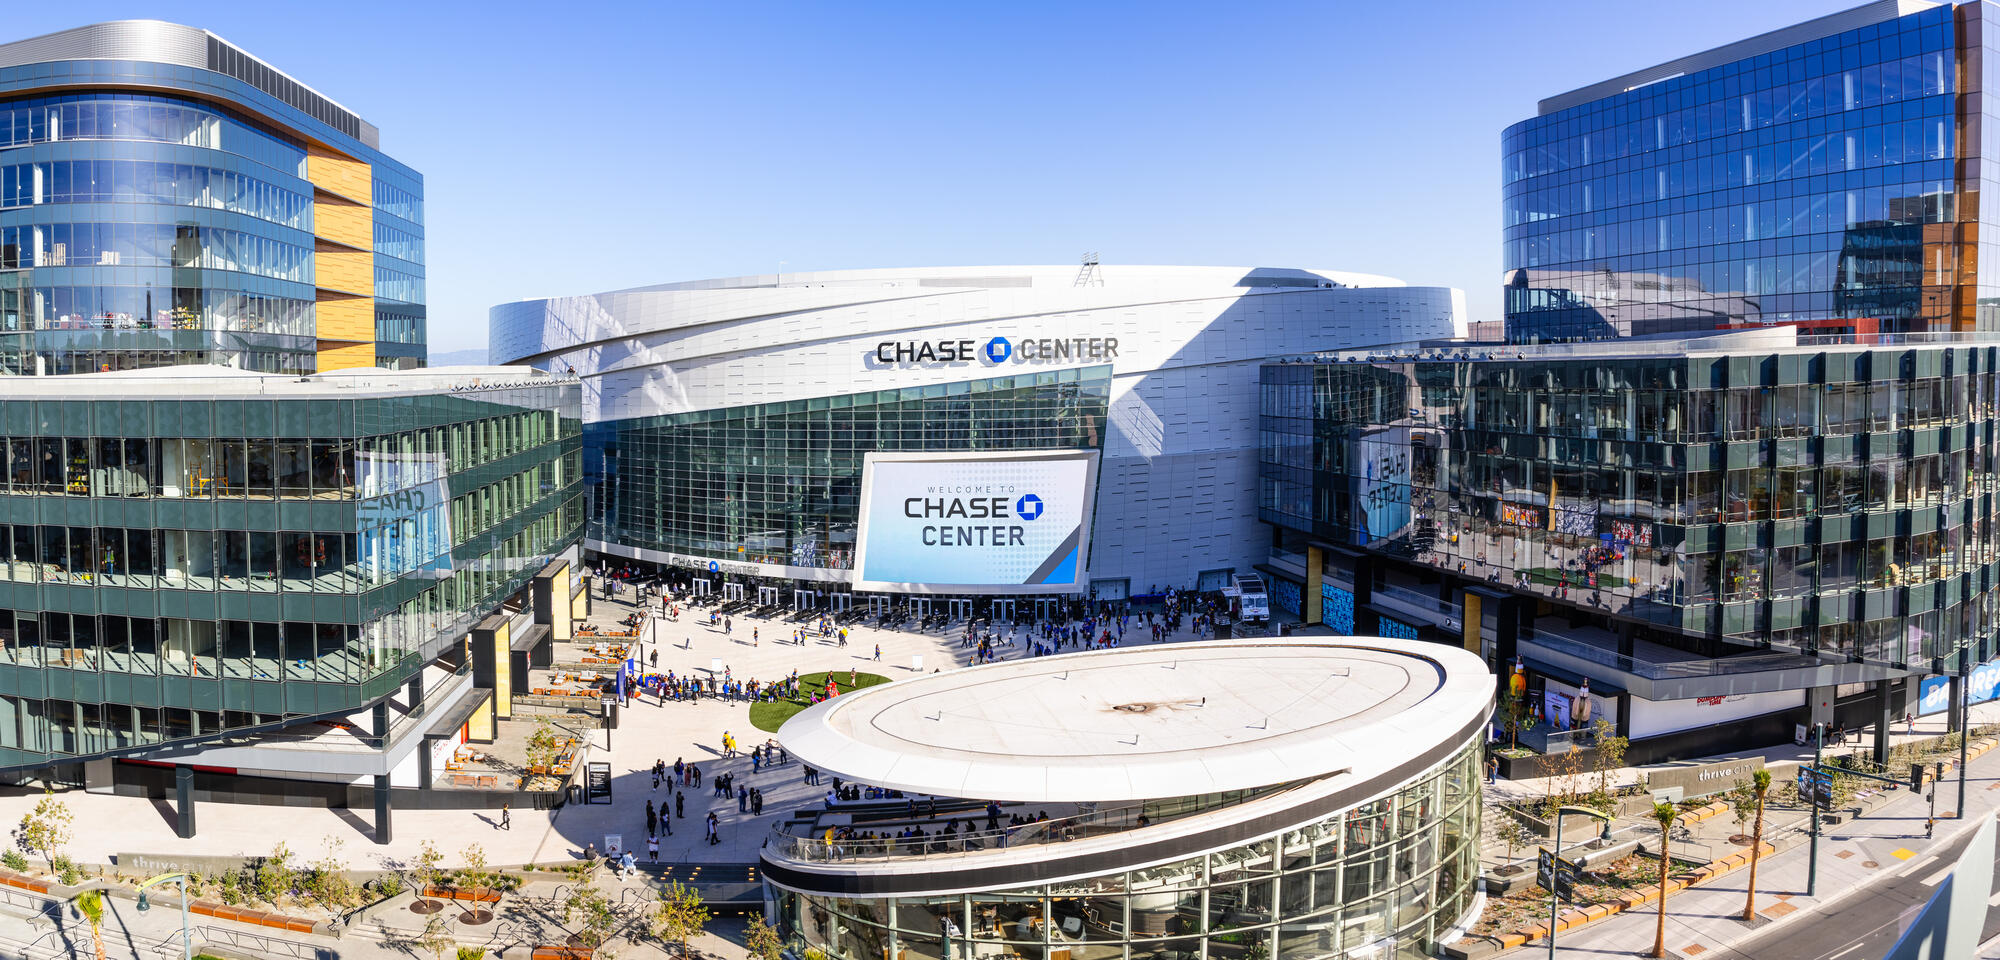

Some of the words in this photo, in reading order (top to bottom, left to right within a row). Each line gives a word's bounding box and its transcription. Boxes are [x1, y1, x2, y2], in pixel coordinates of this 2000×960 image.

[877, 340, 976, 362] CHASE
[1021, 337, 1119, 359] CENTER
[927, 486, 991, 494] WELCOME
[1000, 485, 1015, 493] TO
[904, 497, 1010, 519] CHASE
[922, 525, 1025, 547] CENTER
[672, 557, 707, 569] CHASE
[721, 563, 760, 575] CENTER
[1699, 769, 1731, 781] thrive
[1734, 764, 1754, 774] CITY
[132, 856, 178, 870] thrive
[182, 863, 213, 872] CITY
